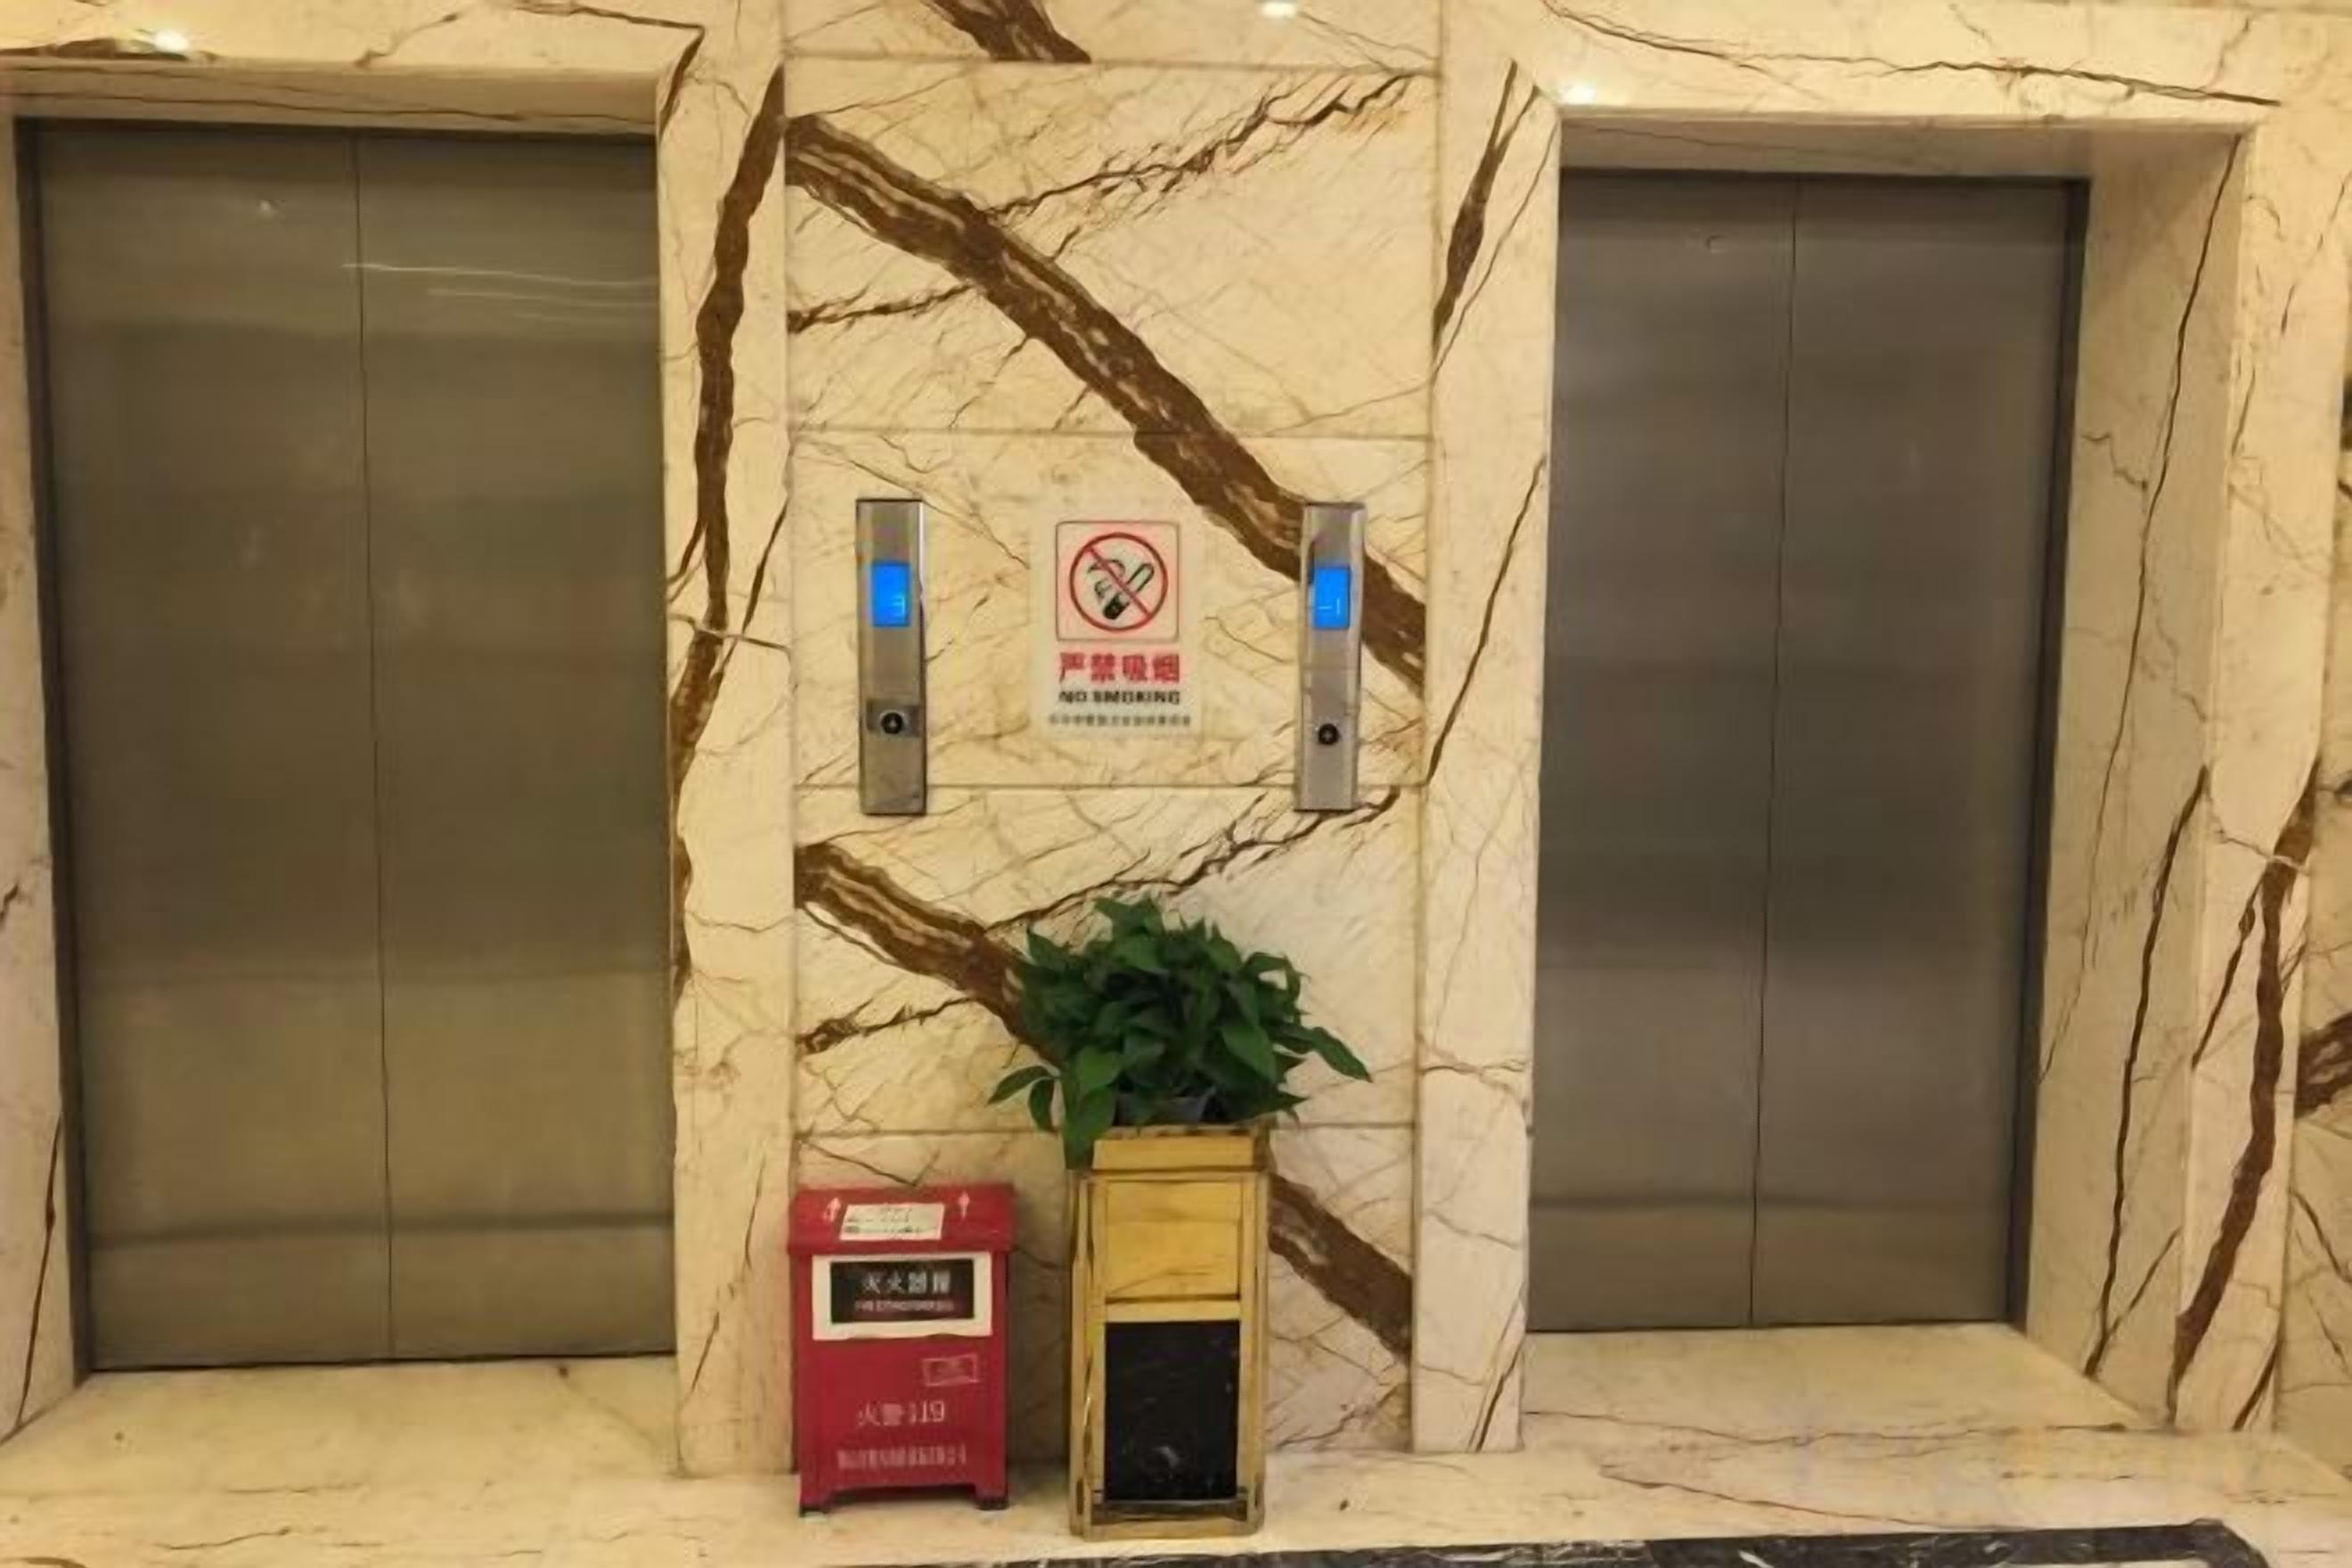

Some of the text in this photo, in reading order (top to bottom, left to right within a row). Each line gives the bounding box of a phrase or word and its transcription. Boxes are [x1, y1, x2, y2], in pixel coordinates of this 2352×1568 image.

[1059, 652, 1180, 683] 严禁吸烟
[1058, 690, 1180, 705] NO SMOKING
